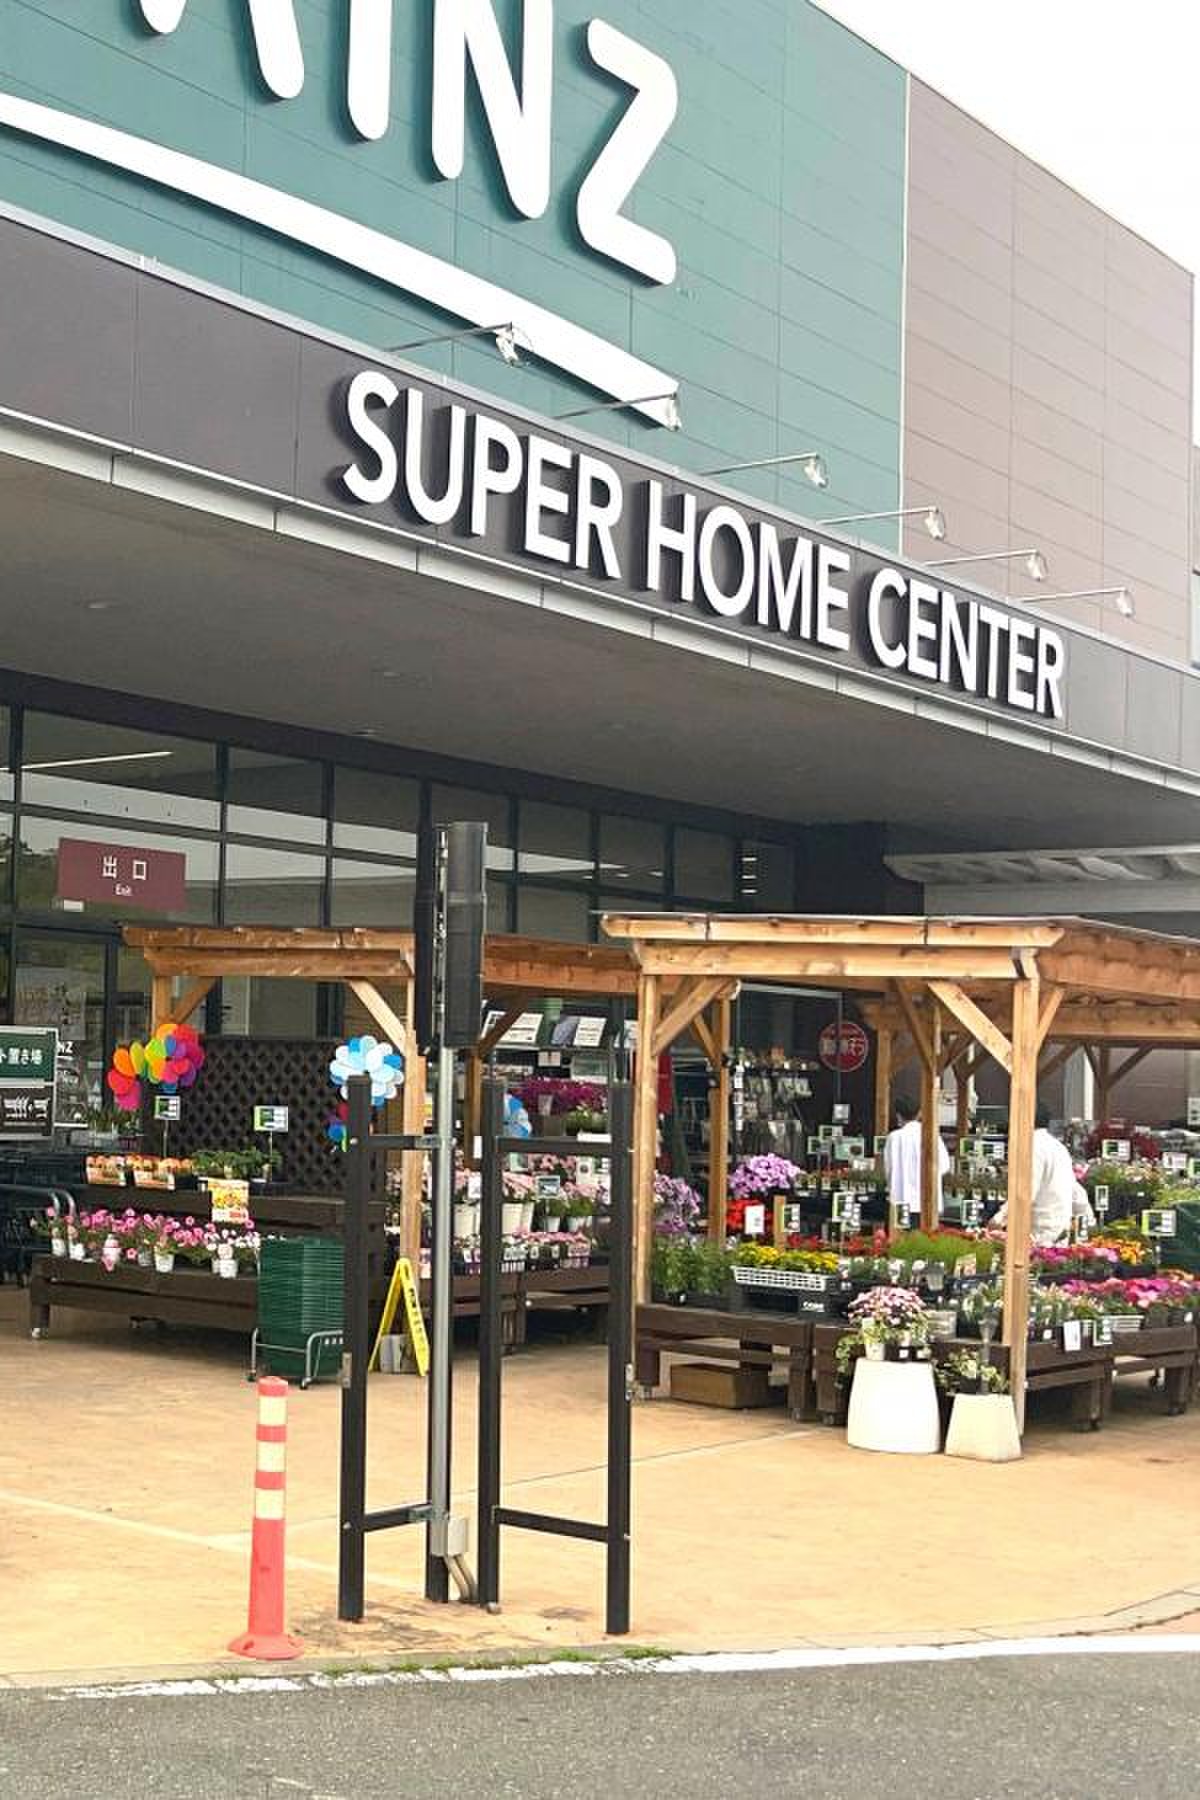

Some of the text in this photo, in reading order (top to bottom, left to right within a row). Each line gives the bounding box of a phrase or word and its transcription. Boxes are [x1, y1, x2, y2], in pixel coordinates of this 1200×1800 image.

[342, 371, 1065, 719] SUPER HOME CENTER
[102, 855, 147, 880] 出口
